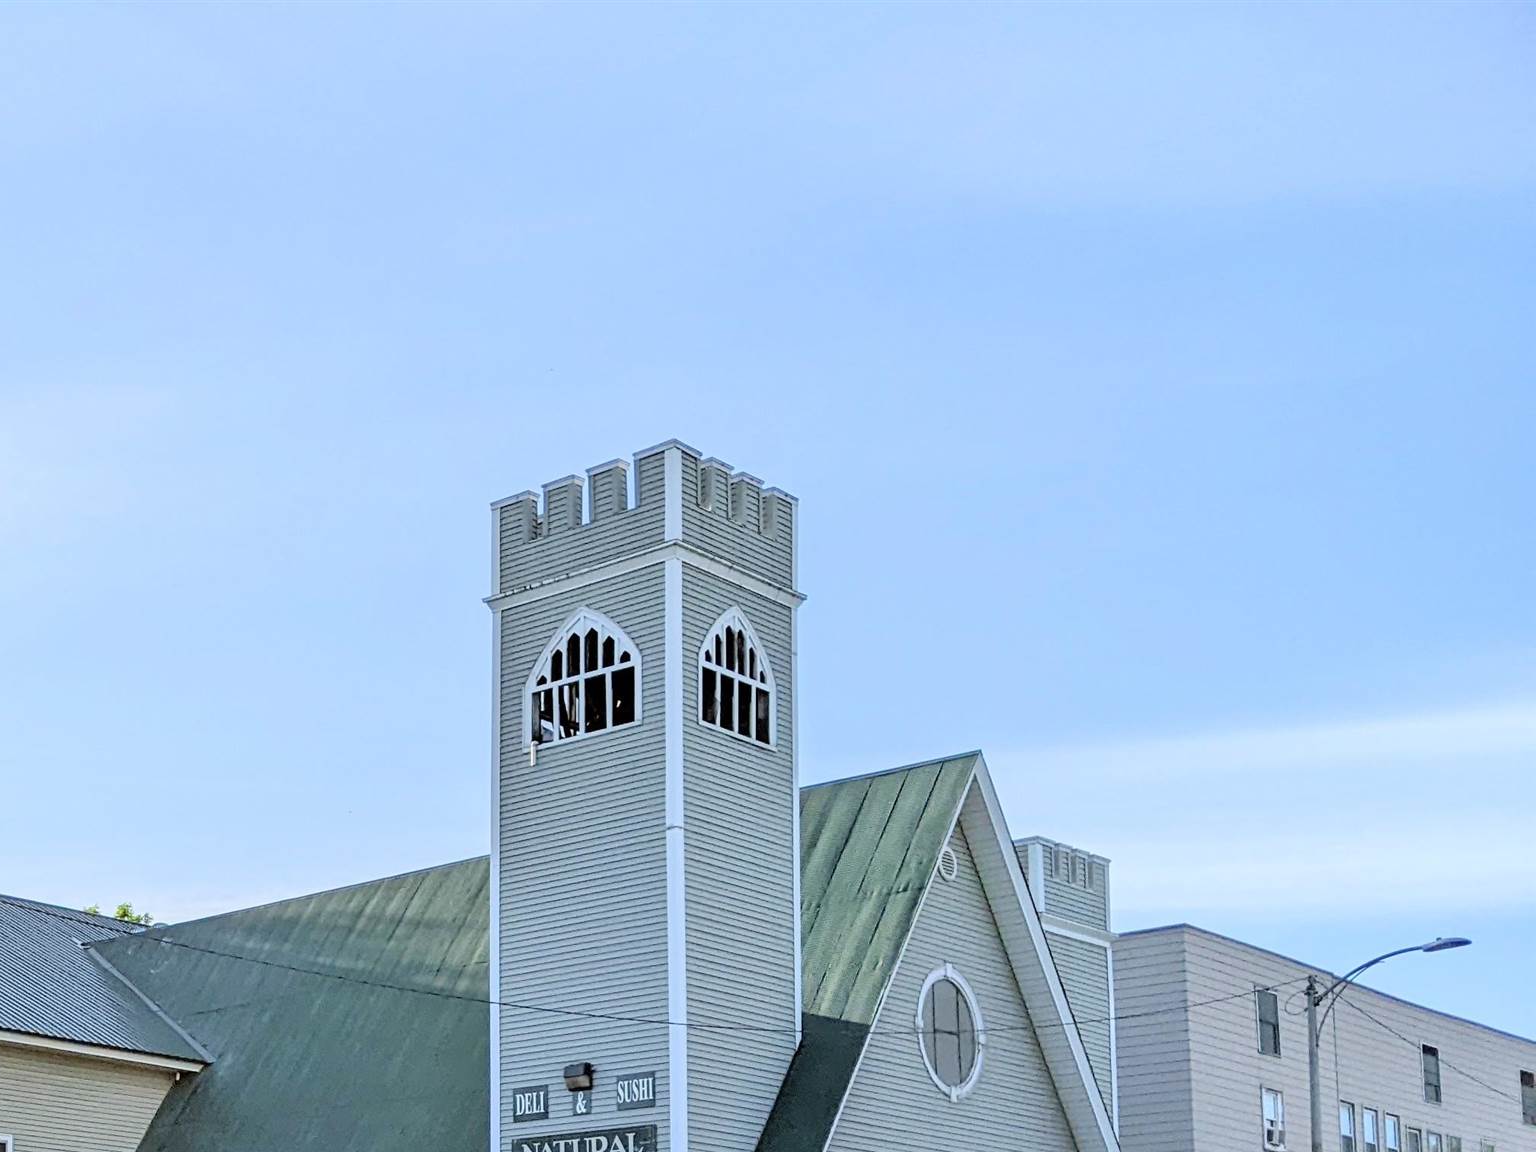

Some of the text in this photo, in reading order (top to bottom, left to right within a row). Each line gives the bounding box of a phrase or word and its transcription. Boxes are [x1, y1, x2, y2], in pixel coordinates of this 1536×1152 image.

[515, 1077, 654, 1116] DELI & SUSHI
